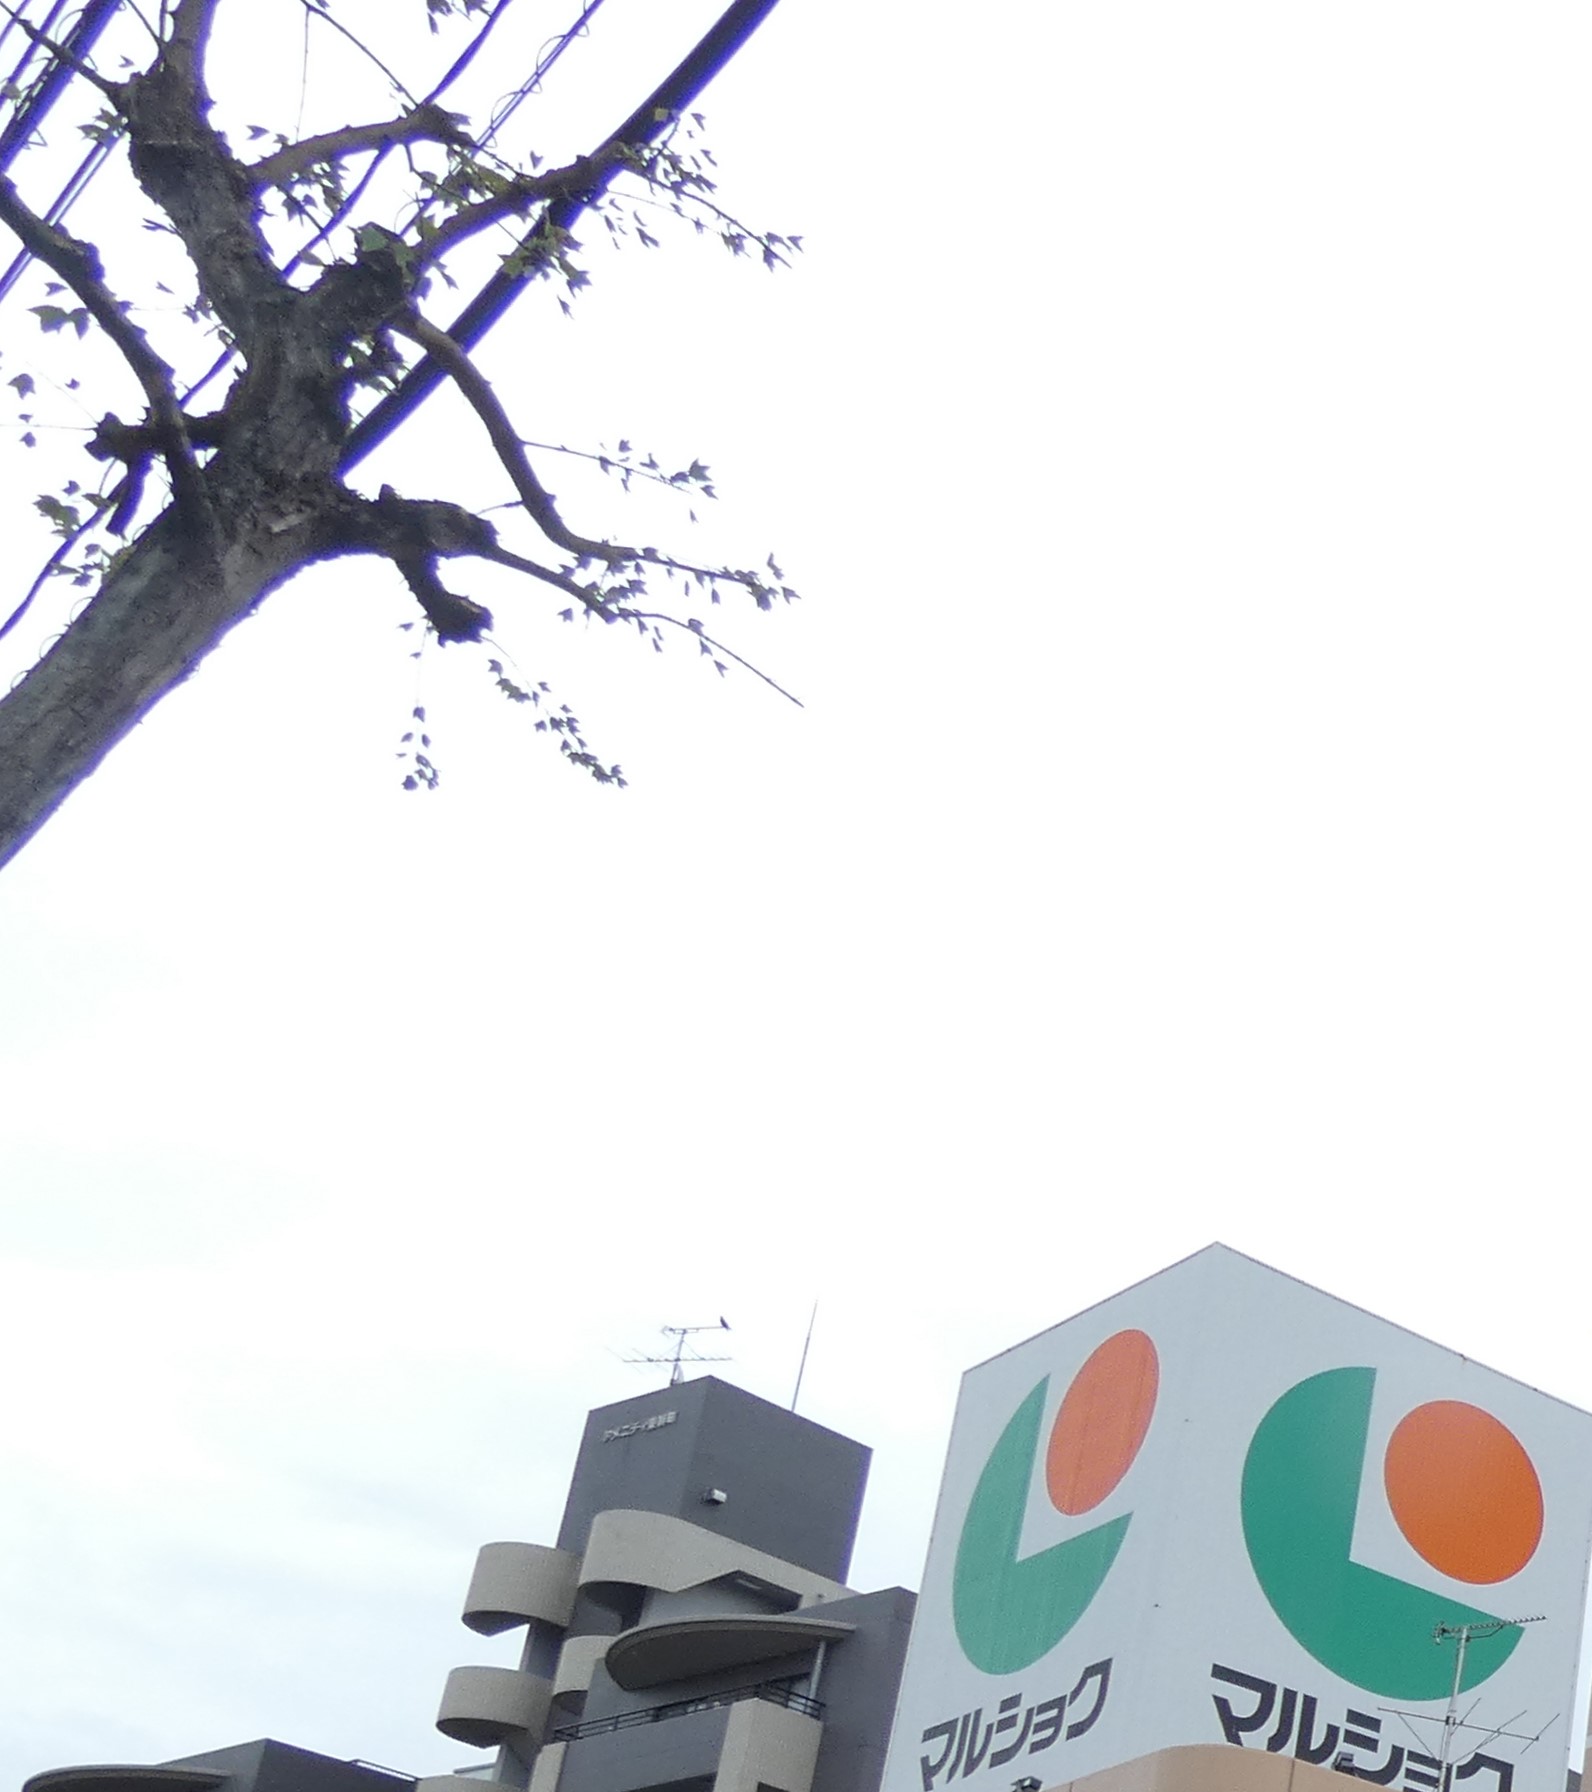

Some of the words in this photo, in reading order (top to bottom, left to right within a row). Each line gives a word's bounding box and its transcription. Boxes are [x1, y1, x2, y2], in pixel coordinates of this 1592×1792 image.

[920, 1657, 1113, 1792] マルショク
